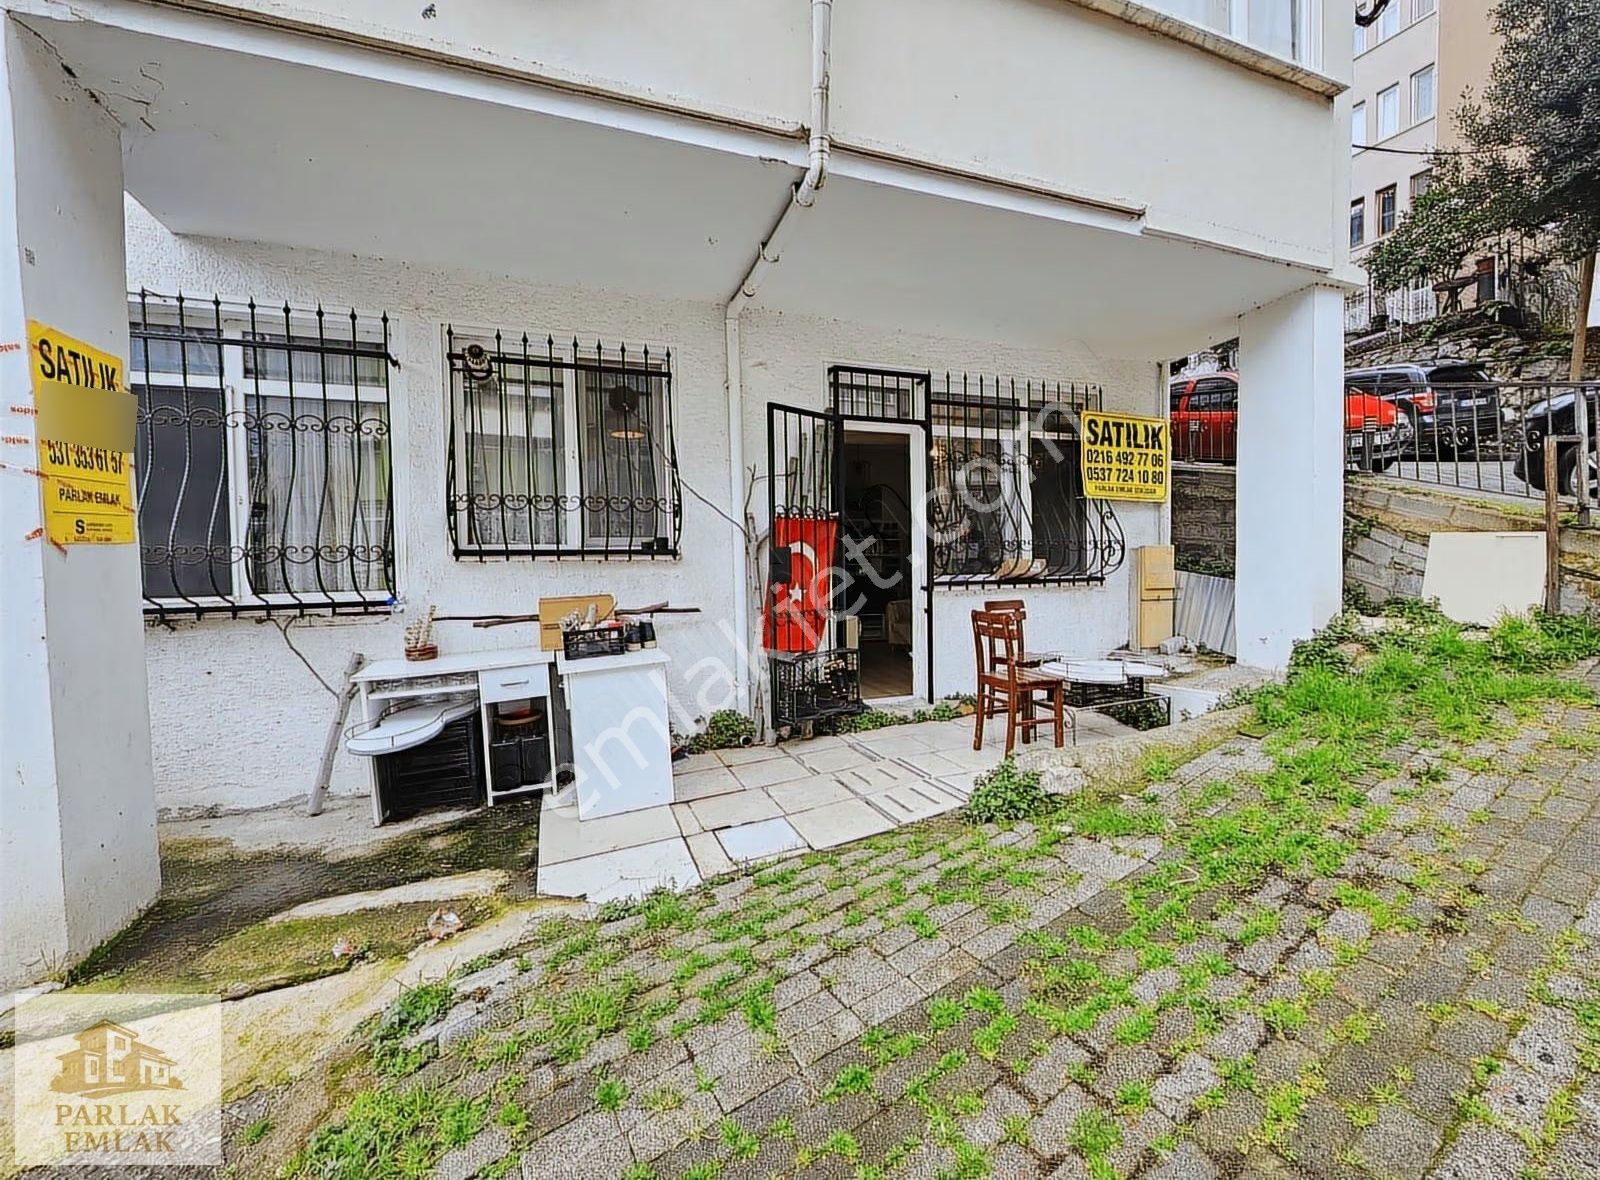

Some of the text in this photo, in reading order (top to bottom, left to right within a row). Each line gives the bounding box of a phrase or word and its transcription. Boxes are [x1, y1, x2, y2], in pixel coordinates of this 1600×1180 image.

[1087, 418, 1163, 450] SATILIK
[1086, 448, 1113, 464] 0216
[1116, 450, 1135, 466] 492
[1137, 452, 1149, 467] 77
[1086, 466, 1164, 485] 0537 724 10 80
